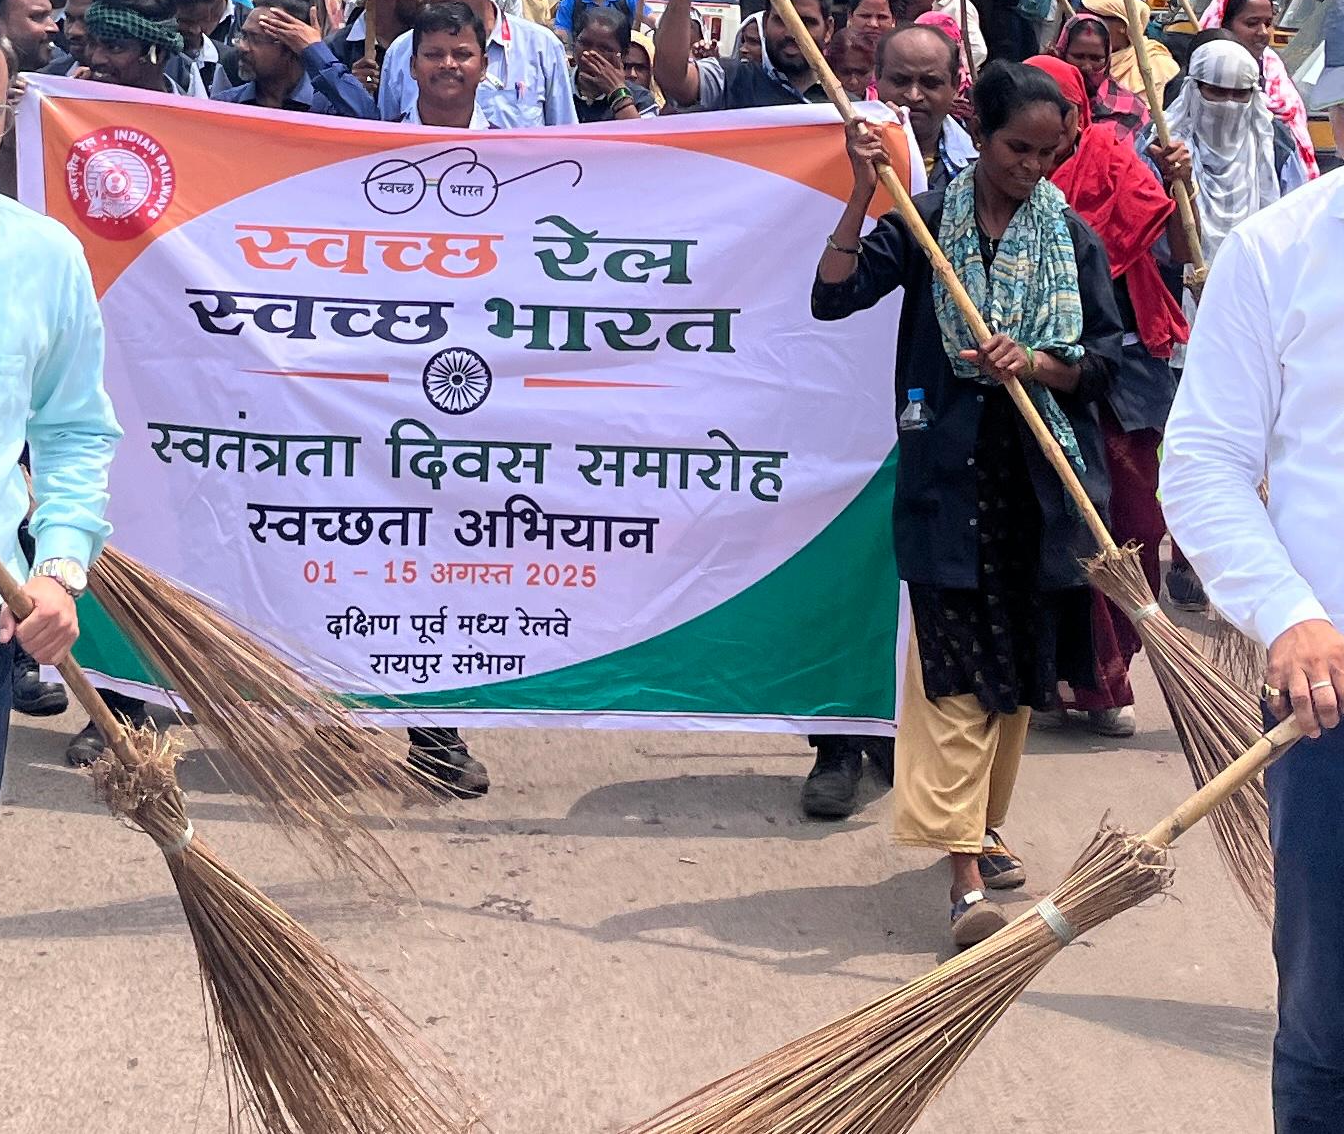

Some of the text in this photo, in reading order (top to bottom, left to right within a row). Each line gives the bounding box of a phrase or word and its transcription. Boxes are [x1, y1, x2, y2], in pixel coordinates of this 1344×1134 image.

[115, 130, 173, 219] INDIAN RAILWAYS
[378, 182, 484, 198] स्वच्छ भारत
[235, 214, 698, 284] स्वच्छ रेल
[186, 288, 741, 354] स्वच्छ भारत
[147, 410, 789, 503] स्वतंत्रता दिवस समारोह
[247, 494, 660, 553] स्वच्छता अभियान
[303, 560, 337, 584] 01
[384, 560, 418, 584] 15
[431, 562, 513, 585] अगस्त
[526, 564, 597, 588] 2025
[326, 606, 572, 644] दक्षिण पूर्व मध्य रेलवे
[370, 644, 525, 683] रायपुर संभाग
